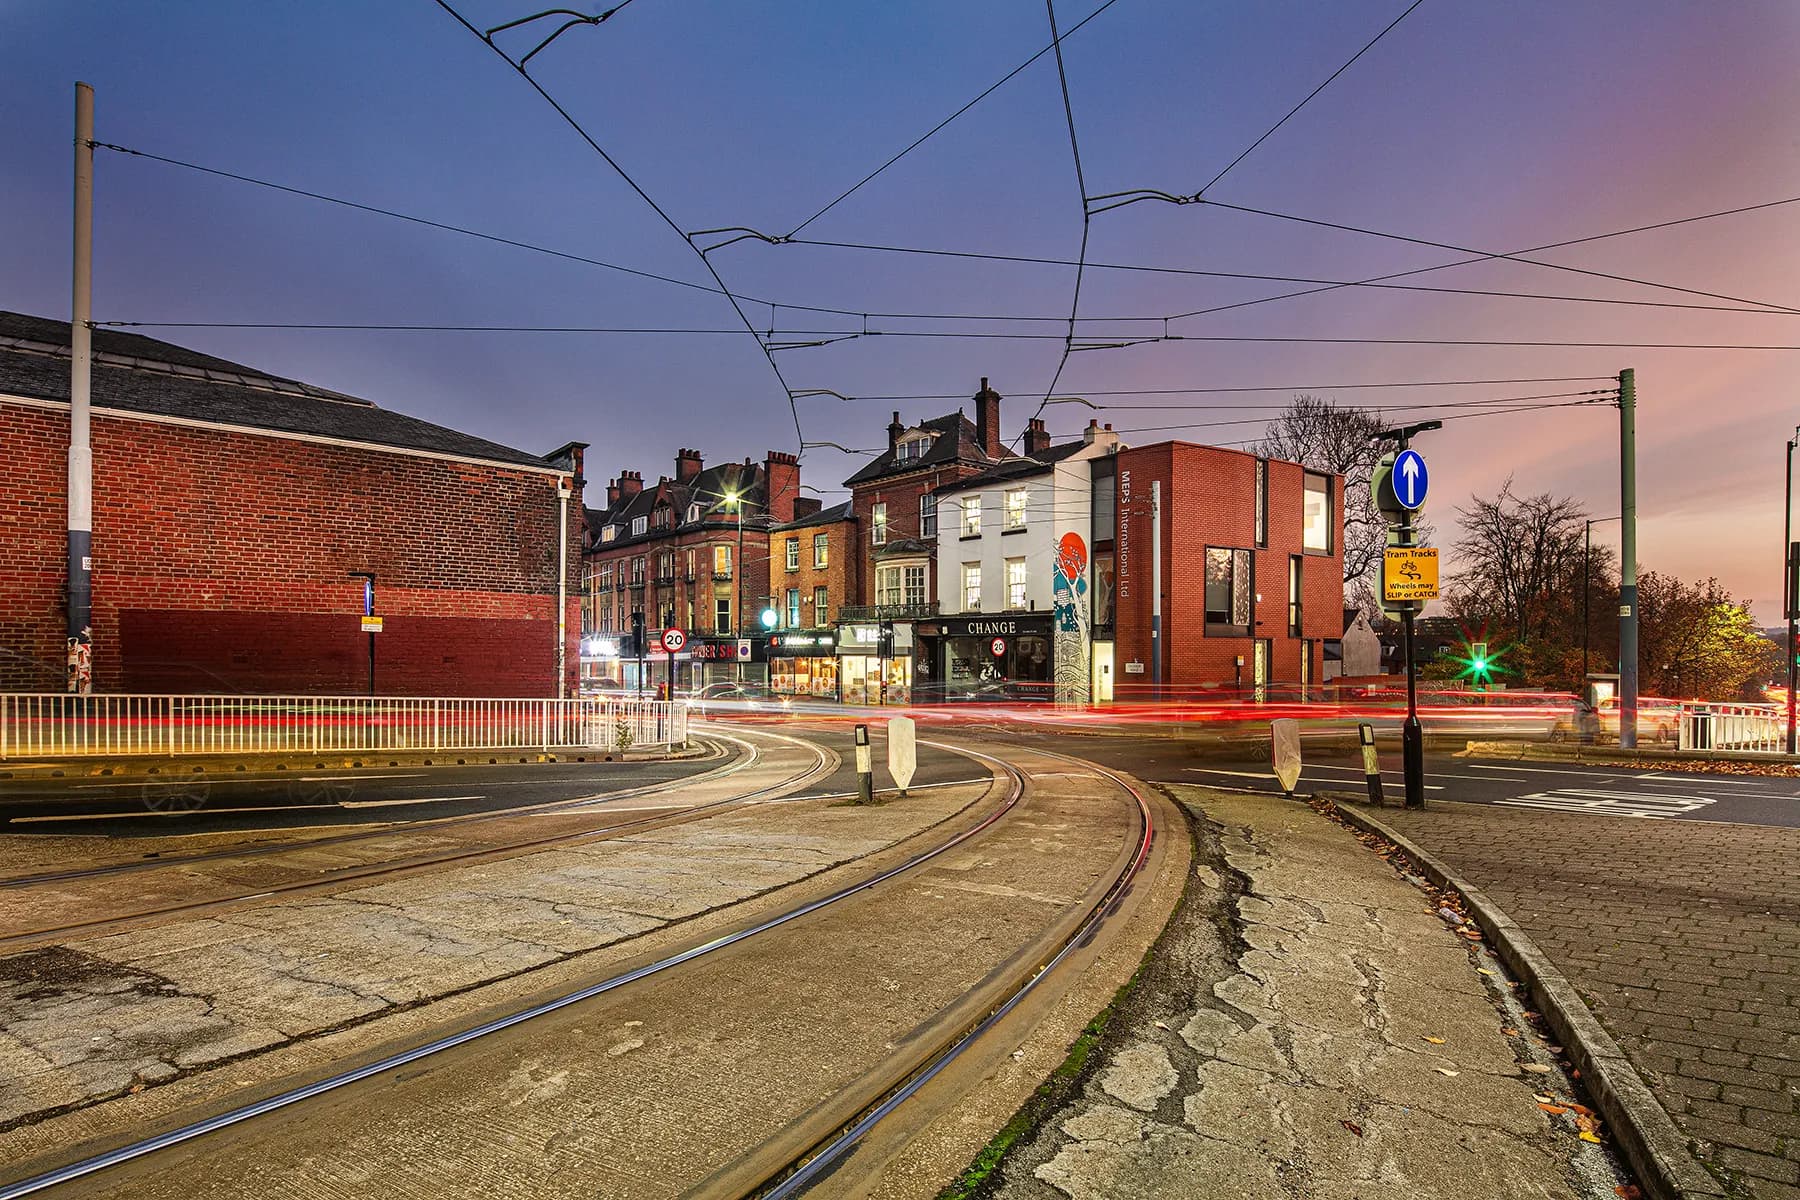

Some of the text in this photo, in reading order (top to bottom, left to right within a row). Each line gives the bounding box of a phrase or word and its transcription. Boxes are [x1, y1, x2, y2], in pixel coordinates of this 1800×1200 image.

[1120, 471, 1130, 597] MEPS International Ltd
[1410, 550, 1437, 558] Tracks
[968, 622, 1016, 634] CHANGE
[666, 635, 683, 645] 20
[994, 643, 1003, 651] 20
